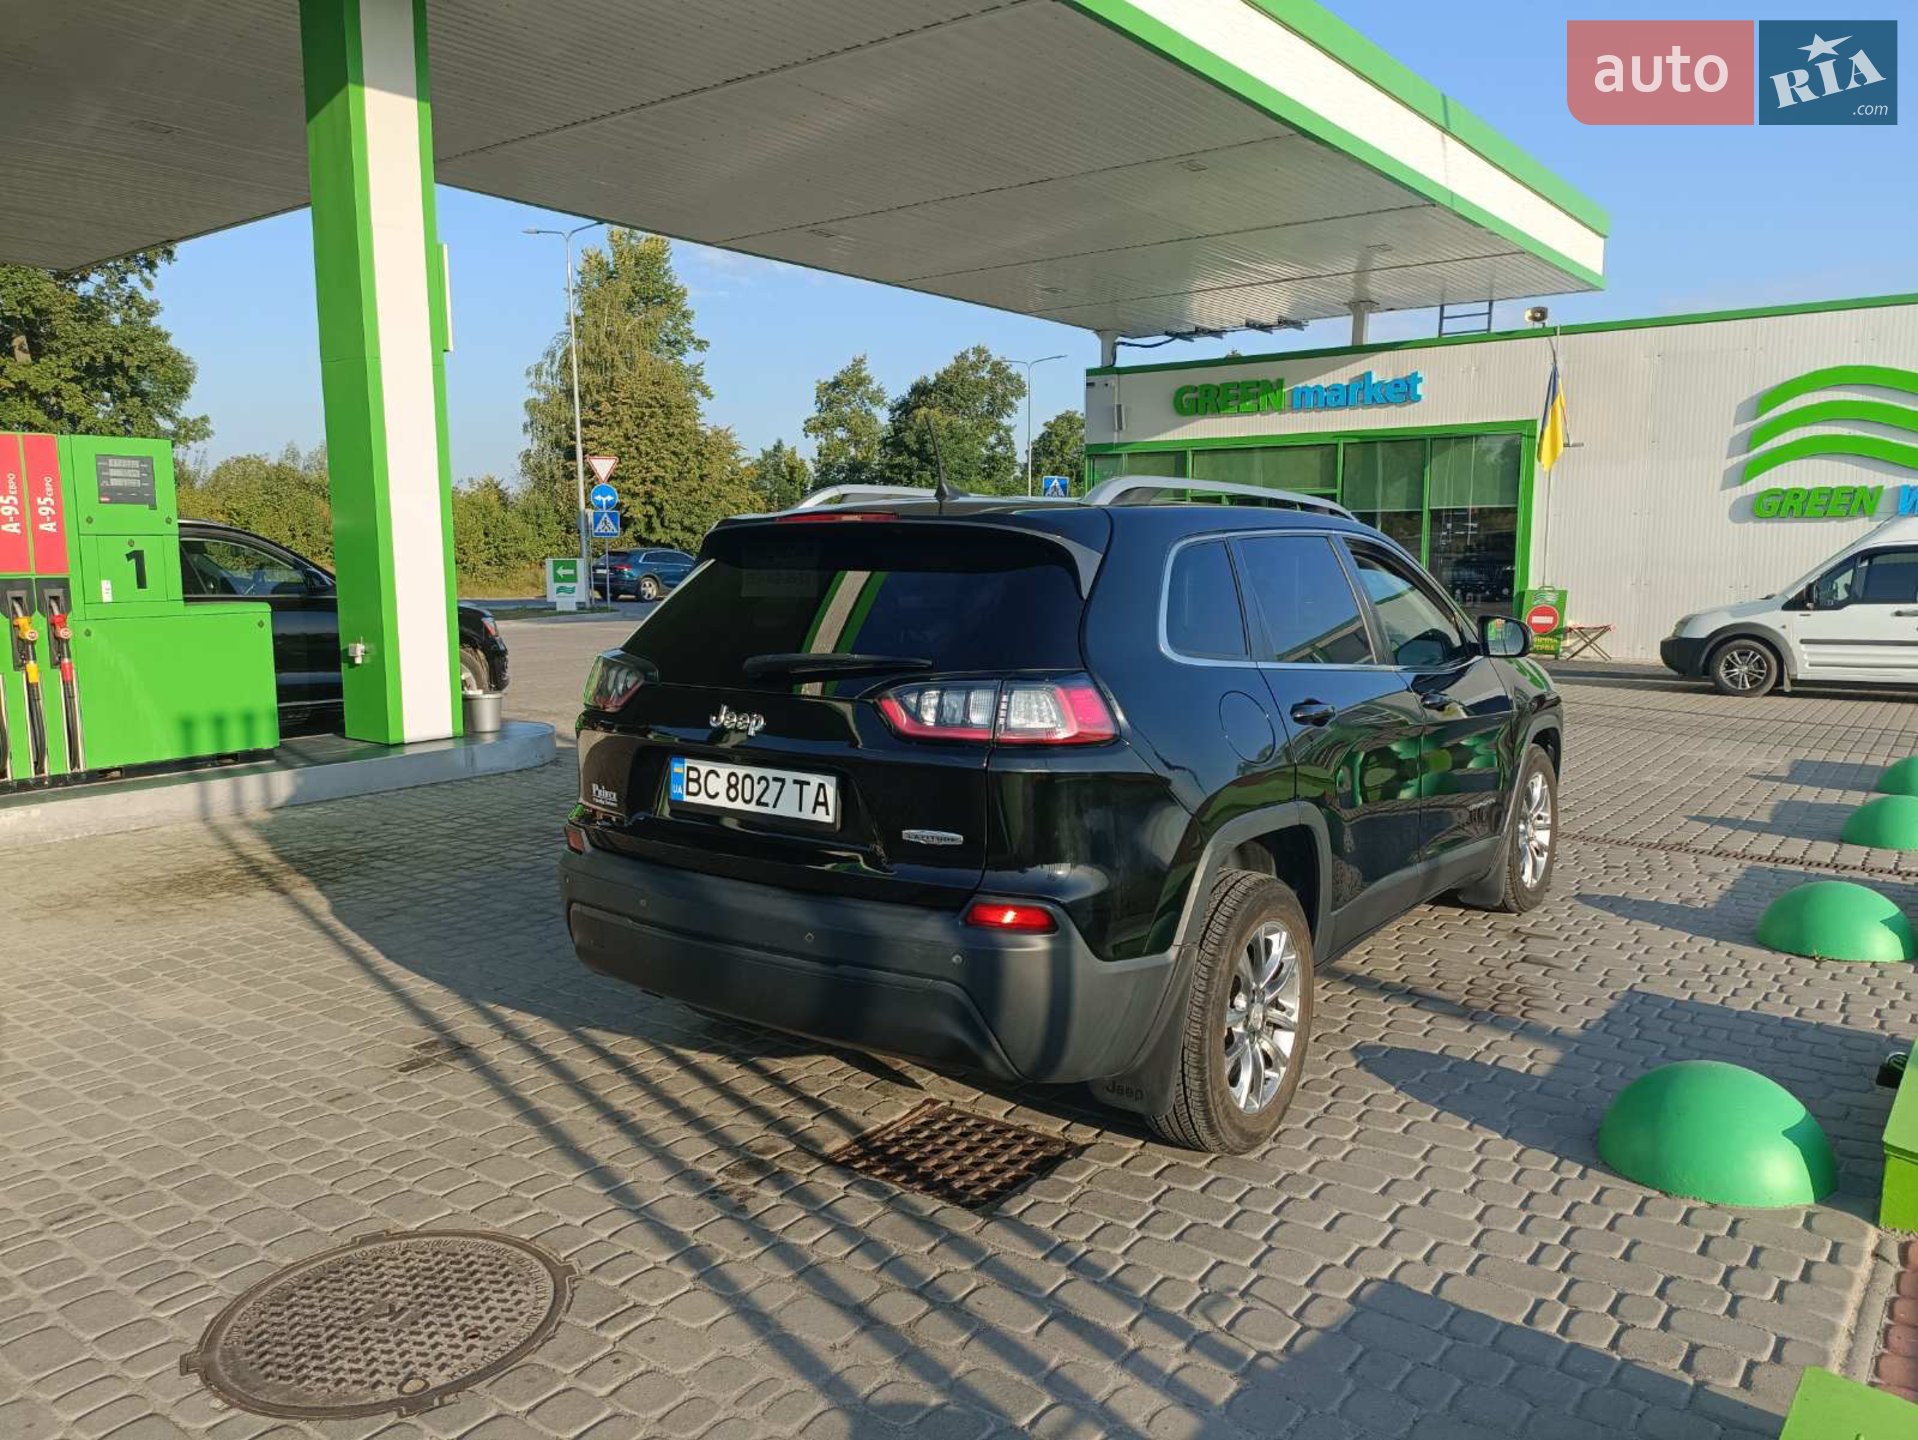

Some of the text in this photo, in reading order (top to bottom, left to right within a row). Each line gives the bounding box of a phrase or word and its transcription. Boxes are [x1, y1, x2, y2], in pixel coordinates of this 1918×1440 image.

[1173, 370, 1423, 417] GREEN market
[1753, 485, 1884, 518] GREEN
[125, 550, 147, 589] 1
[709, 703, 766, 737] Jeep
[672, 782, 683, 795] UA
[686, 766, 831, 816] BC 8027 TA
